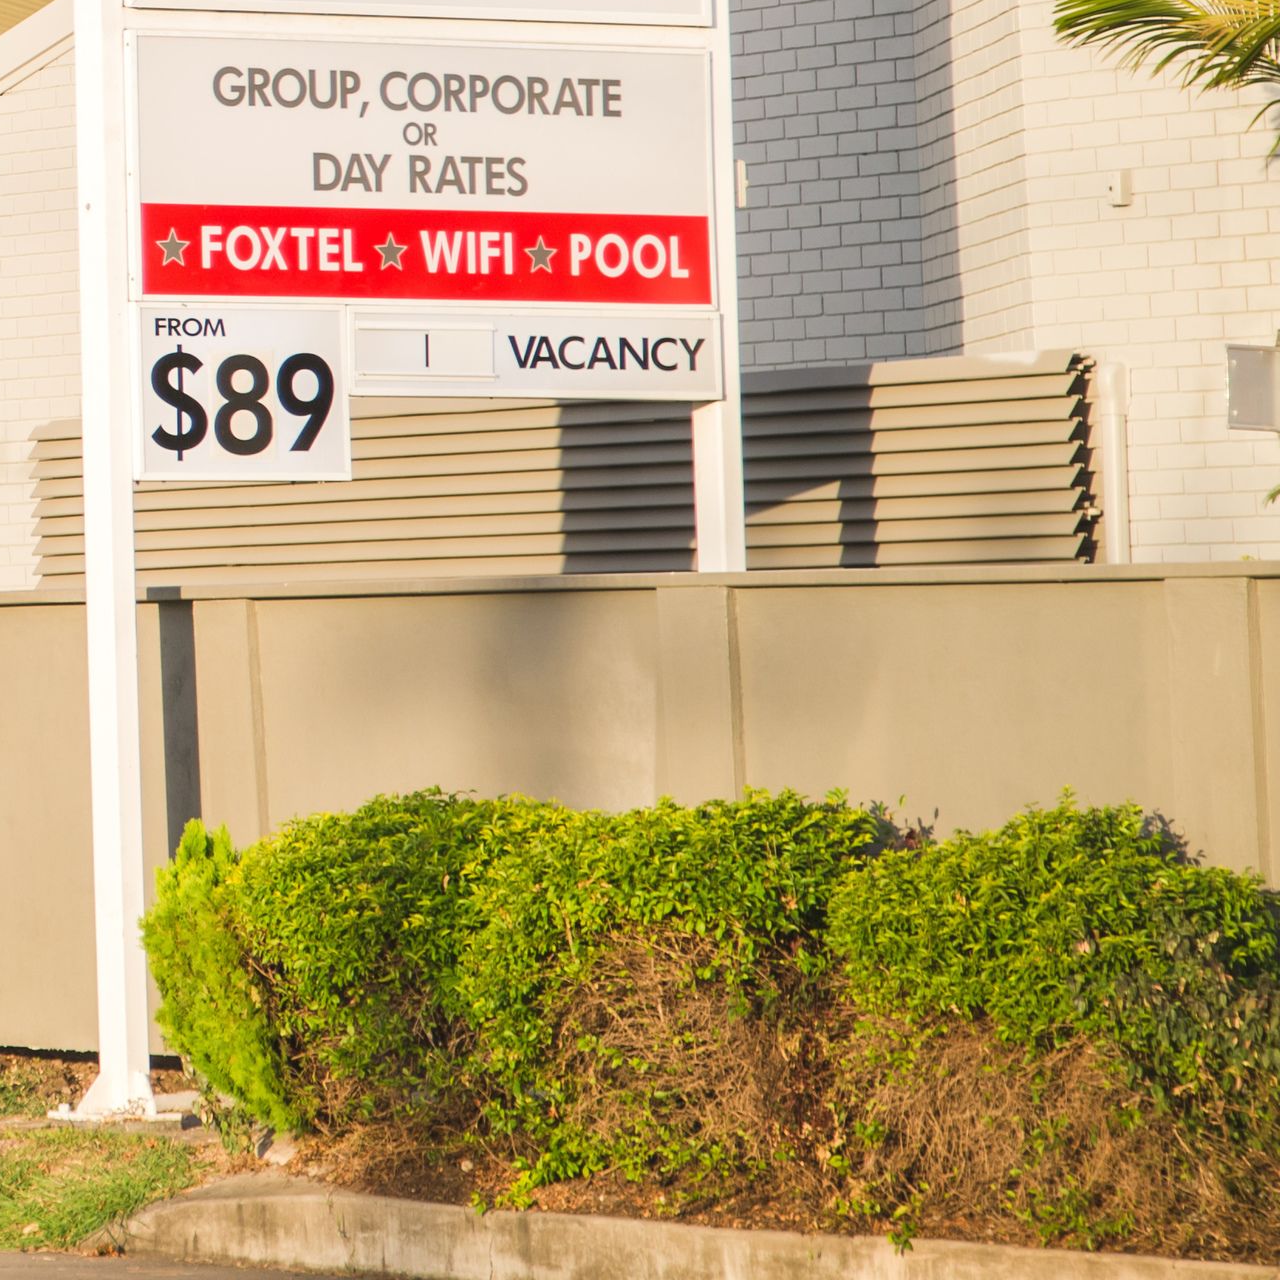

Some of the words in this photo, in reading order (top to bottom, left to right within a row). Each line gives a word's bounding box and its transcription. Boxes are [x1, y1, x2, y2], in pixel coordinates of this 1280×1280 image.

[212, 65, 370, 118] GROUP,
[379, 70, 623, 118] CORPORATE
[402, 121, 438, 147] OR
[312, 152, 392, 193] DAY
[408, 155, 529, 197] RATES
[201, 225, 364, 272] FOXTEL
[419, 230, 514, 275] WIFI
[570, 233, 689, 279] POOL
[154, 317, 226, 337] FROM
[508, 335, 706, 372] VACANCY
[151, 344, 335, 461] $89
